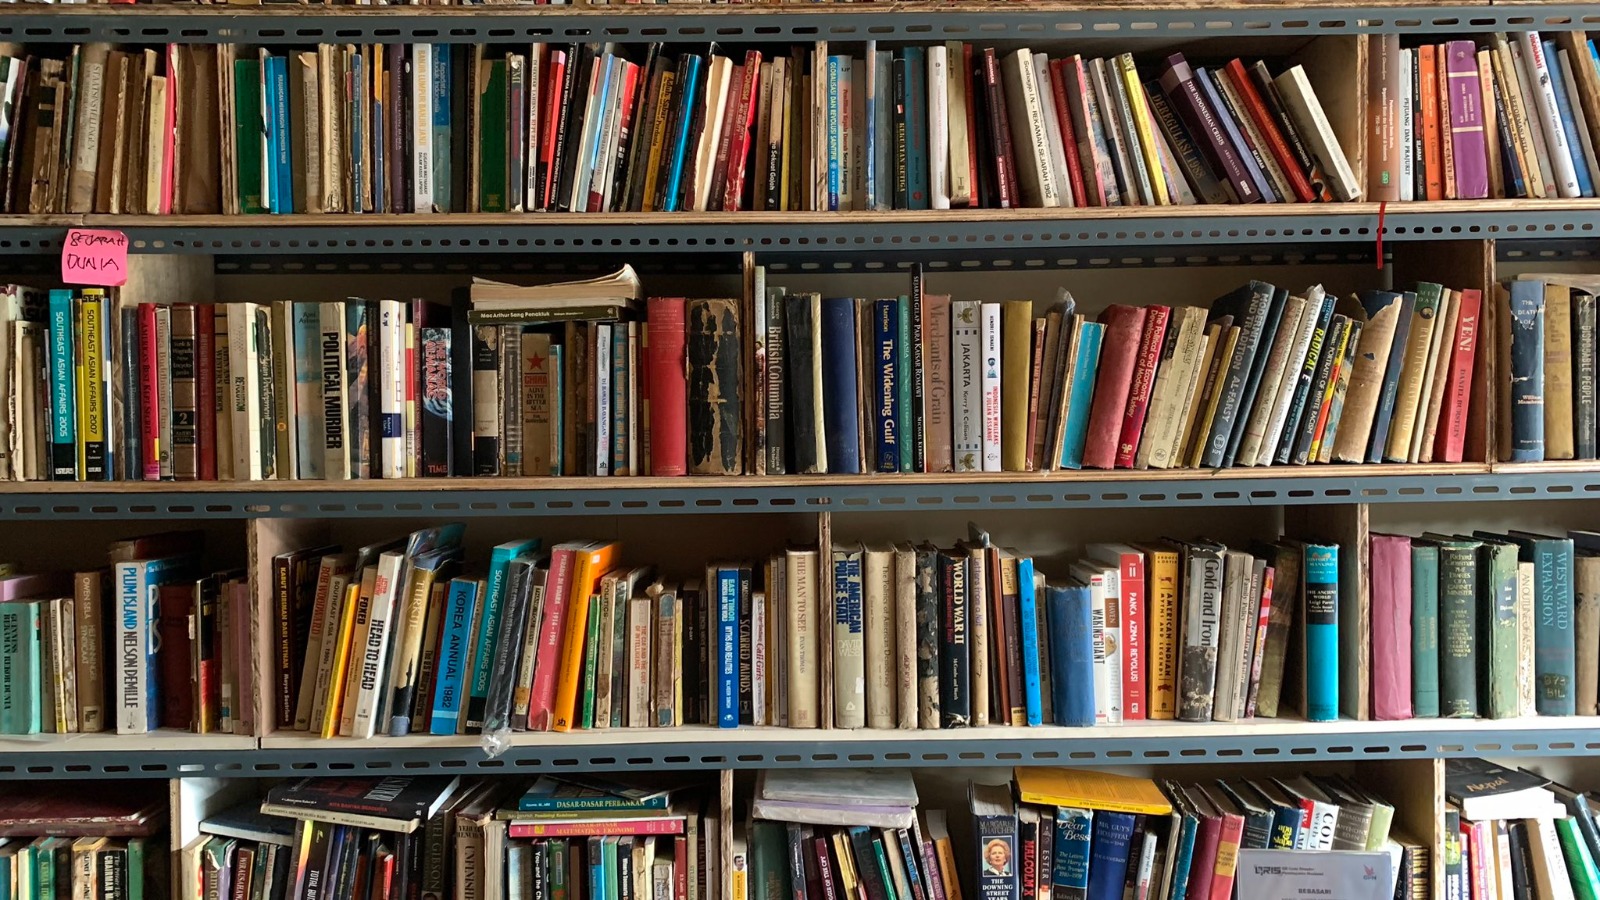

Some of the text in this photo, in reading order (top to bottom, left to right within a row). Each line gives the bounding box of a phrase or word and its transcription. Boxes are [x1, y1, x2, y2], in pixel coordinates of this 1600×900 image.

[1186, 81, 1198, 92] THE
[1031, 110, 1044, 146] REKAMAN
[1150, 94, 1191, 156] DEREGULASI
[1191, 92, 1215, 127] INDONESIAN
[1212, 127, 1224, 146] CRISIS
[1037, 149, 1048, 181] SEJARAH
[1043, 183, 1052, 199] 1982
[67, 254, 119, 270] DUNIA
[56, 311, 64, 356] SOUTHEAST
[1140, 309, 1158, 357] Development
[1246, 293, 1269, 351] MODERNITY
[425, 340, 436, 400] ALMANAC
[436, 341, 447, 400] THE WORLD
[882, 340, 893, 362] The
[930, 304, 945, 425] Merchants of Grain
[961, 343, 971, 387] JAKARTA
[1138, 311, 1166, 402] The Political and Economic
[1221, 292, 1261, 422] AND TRADITION AL-FARSY
[1304, 327, 1325, 372] RADICAL
[1581, 325, 1592, 405] DISPOSABLE PEOPLE
[87, 309, 98, 435] SOUTHEAST ASIAN AFFAIRS 2007
[322, 332, 342, 449] POLITICAL MURDER
[768, 326, 782, 420] British Columbia
[882, 363, 894, 416] Widening
[1132, 367, 1145, 395] Modern
[1306, 322, 1342, 434] Wellman: PORTRAITS OF WHITE RACISM
[1452, 315, 1475, 438] YEN! DANIEL BURSTEIN
[58, 383, 66, 414] AFFAIRS
[1127, 396, 1139, 418] Turkey
[59, 416, 67, 437] 2005
[884, 418, 895, 445] Gulf
[797, 556, 805, 575] THE
[973, 557, 982, 585] Letters
[356, 597, 369, 624] FOXED
[798, 599, 805, 612] TO
[834, 560, 849, 625] POLICE STATE
[846, 559, 861, 633] THE AMERICAN
[953, 562, 964, 644] WORLD WAR II
[974, 588, 983, 605] from
[1201, 559, 1220, 646] Gold and Iron
[1542, 552, 1553, 626] EXPANSION
[1555, 552, 1568, 630] WESTWARD
[123, 568, 138, 708] PLUM ISLAND NELSON DEMILLE
[477, 570, 503, 691] SOUTHEAST ASIAN AFFAIRS 2005
[798, 613, 807, 632] SEE
[1092, 609, 1105, 664] WAKING GIANT
[1129, 620, 1137, 646] AZIMAT
[361, 619, 384, 690] HEAD TO HEAD
[442, 591, 467, 708] KOREA ANNUAL 1982
[739, 619, 751, 693] SCARRED MINDS
[1129, 648, 1138, 682] REVOLUSI
[556, 800, 604, 808] DASAR-DASAR
[1466, 777, 1509, 792] Nepal
[1058, 821, 1086, 830] Dear
[1063, 829, 1090, 841] Bess
[1318, 813, 1334, 848] COL
[104, 856, 114, 891] CHAIRMAN
[430, 816, 441, 889] MEL GIBSON
[1024, 840, 1034, 887] MALCOLM
[1254, 866, 1282, 876] QRIS
[1413, 849, 1429, 874] KIRK
[309, 870, 319, 887] TOTAL
